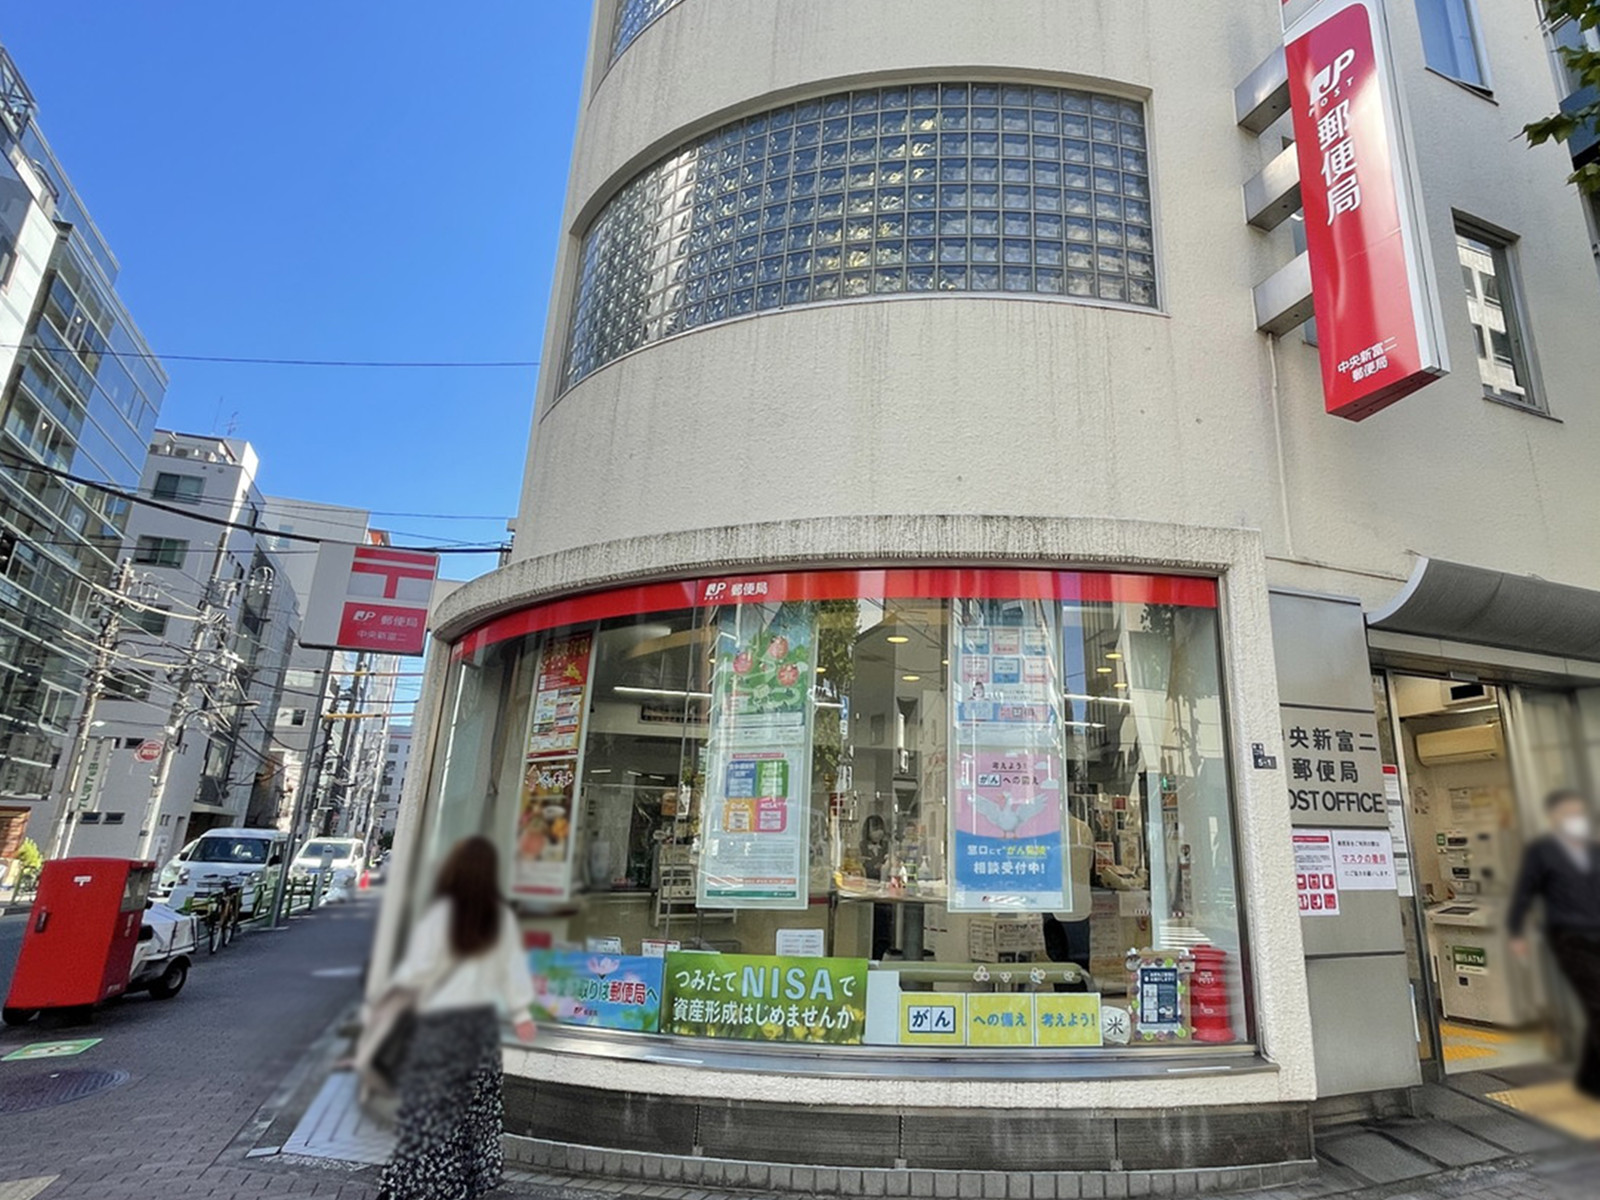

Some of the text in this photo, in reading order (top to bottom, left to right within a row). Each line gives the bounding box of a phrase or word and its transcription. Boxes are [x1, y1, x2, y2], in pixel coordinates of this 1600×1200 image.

[1317, 98, 1361, 226] 郵便局
[1337, 335, 1398, 373] 中央新富二
[1352, 355, 1388, 383] 郵便局
[731, 581, 768, 597] 郵便局
[380, 614, 419, 628] 郵便局
[1281, 726, 1377, 752] 央新富二
[1292, 757, 1359, 783] 郵便局
[1321, 790, 1385, 814] OFFICE
[973, 860, 1045, 875] 相談受付中!
[675, 966, 857, 1001] つみたてNISAで
[673, 997, 855, 1029] 資産形成はじめませんか
[912, 1009, 1096, 1028] がん への備え 考えよう!
